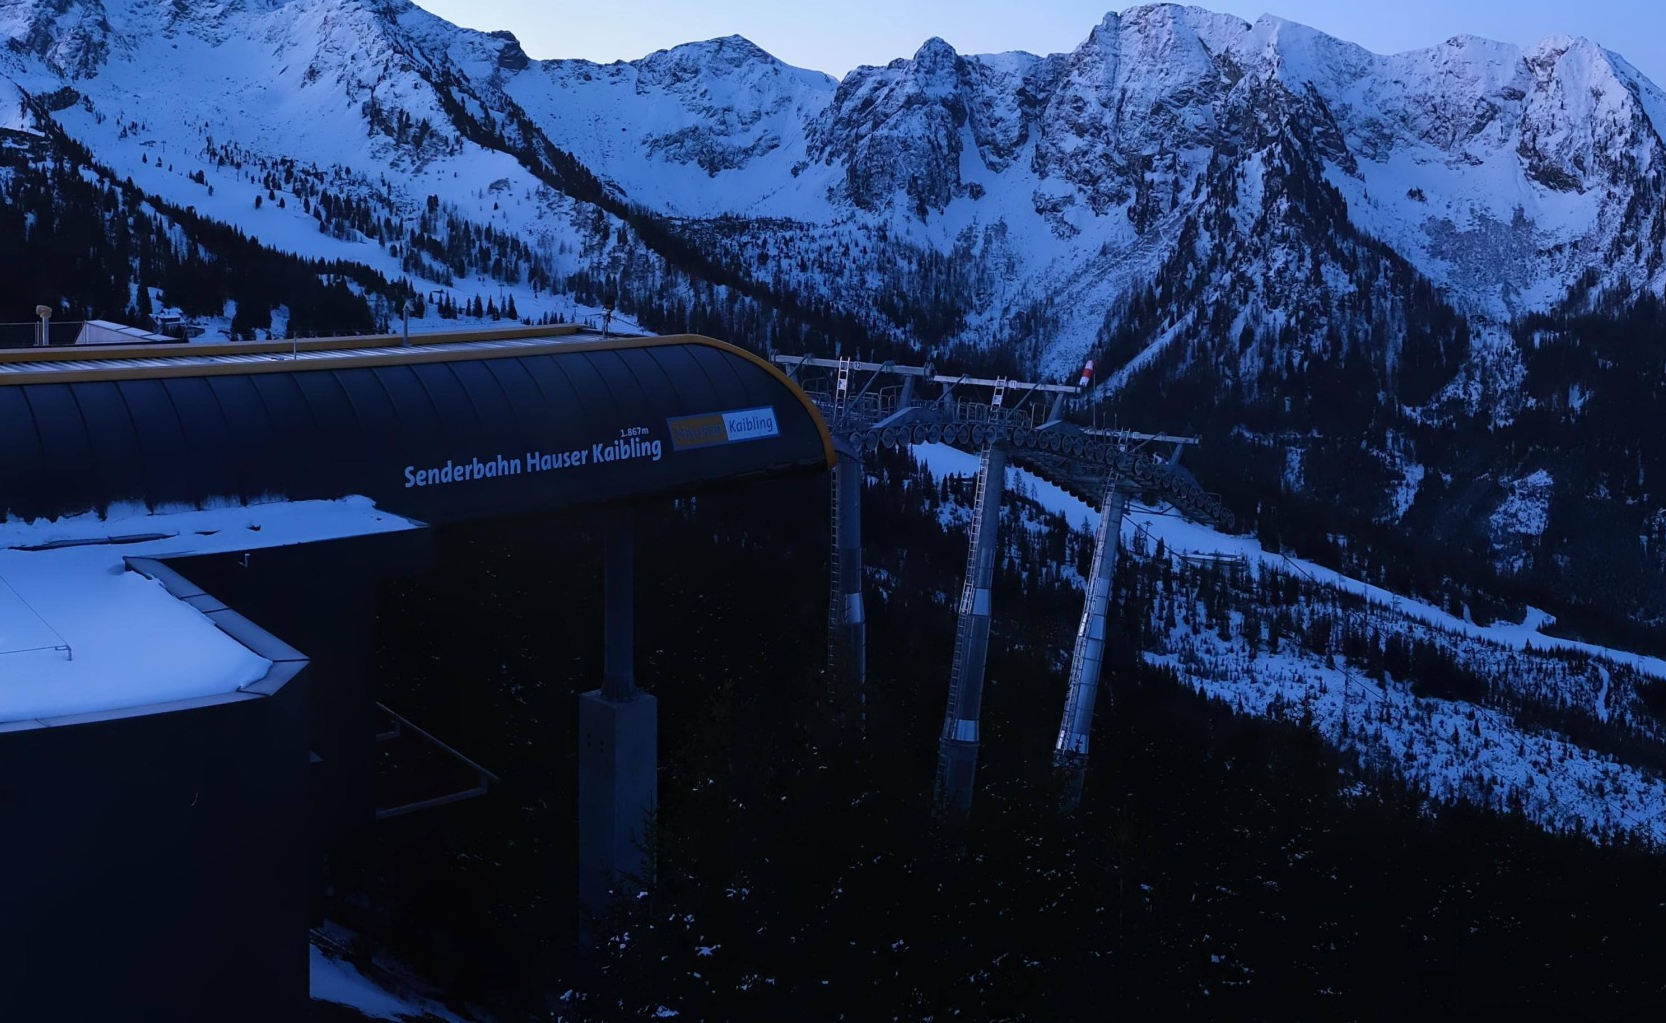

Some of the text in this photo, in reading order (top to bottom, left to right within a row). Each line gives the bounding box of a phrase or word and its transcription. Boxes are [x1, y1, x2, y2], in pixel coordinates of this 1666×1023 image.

[620, 426, 649, 438] 1.867m
[728, 416, 773, 433] Kaibling
[404, 436, 662, 488] Senderbahn Hauser Kaibling
